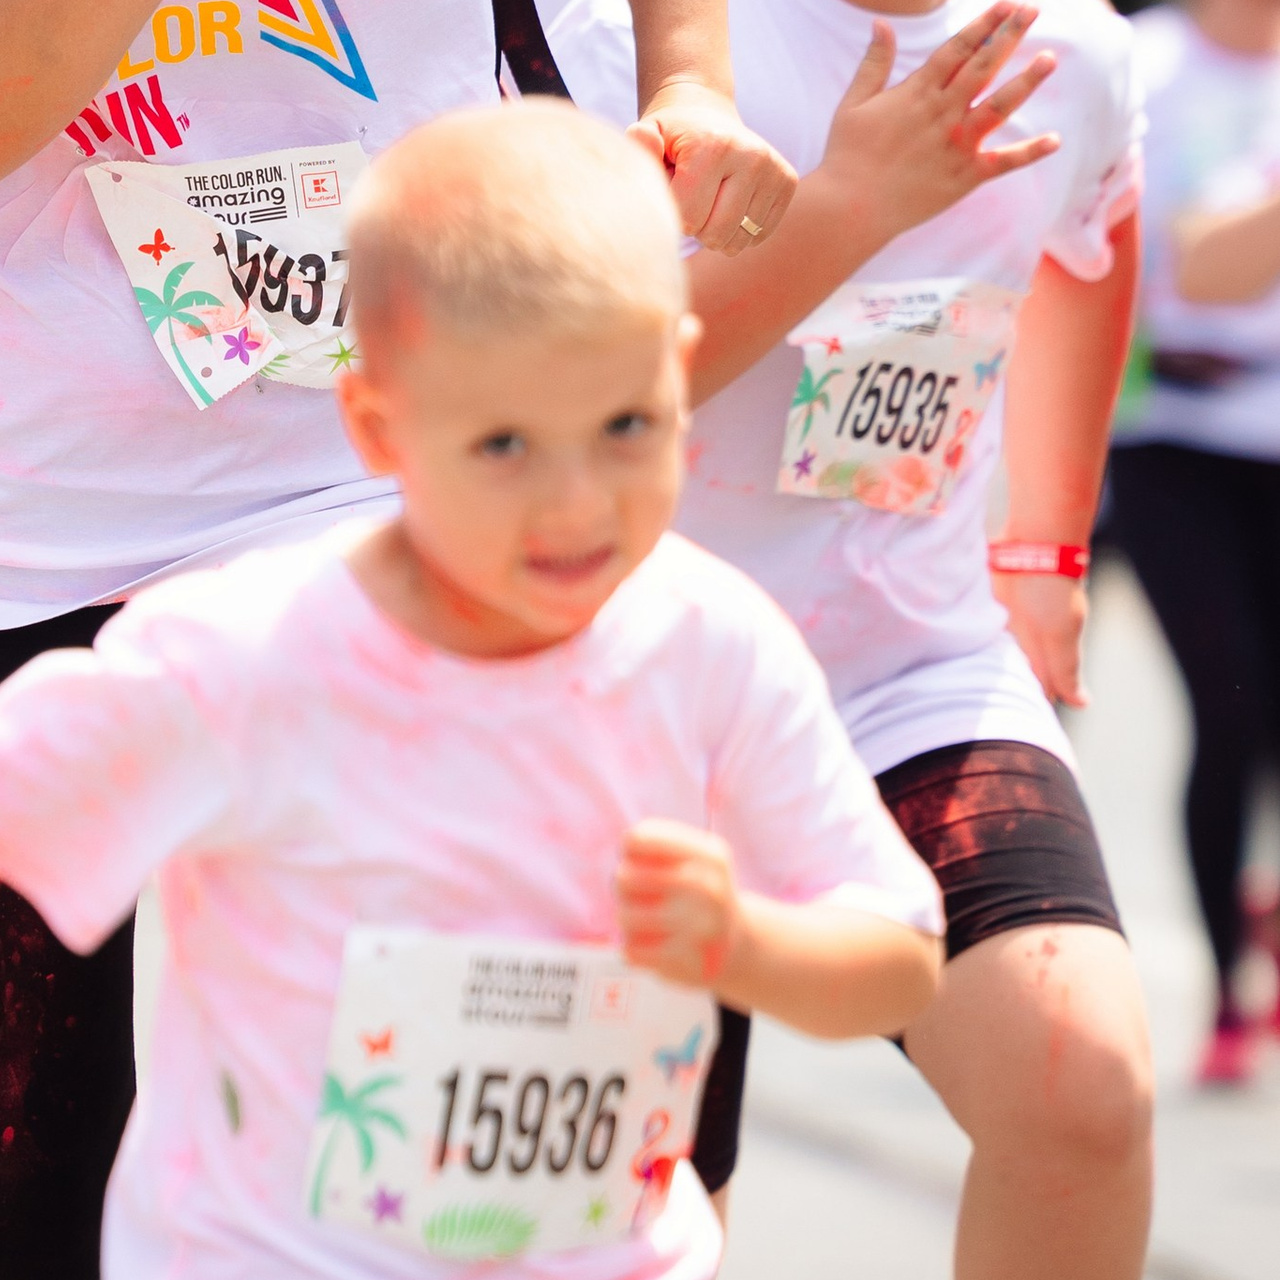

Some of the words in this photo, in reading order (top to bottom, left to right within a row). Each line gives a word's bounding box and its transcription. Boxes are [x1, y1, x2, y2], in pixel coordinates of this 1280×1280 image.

[102, 0, 243, 86] LOR
[185, 176, 210, 191] THE
[211, 170, 254, 190] COLOR
[187, 187, 285, 208] amazing
[836, 362, 958, 454] 15935
[434, 1067, 627, 1175] 15936
